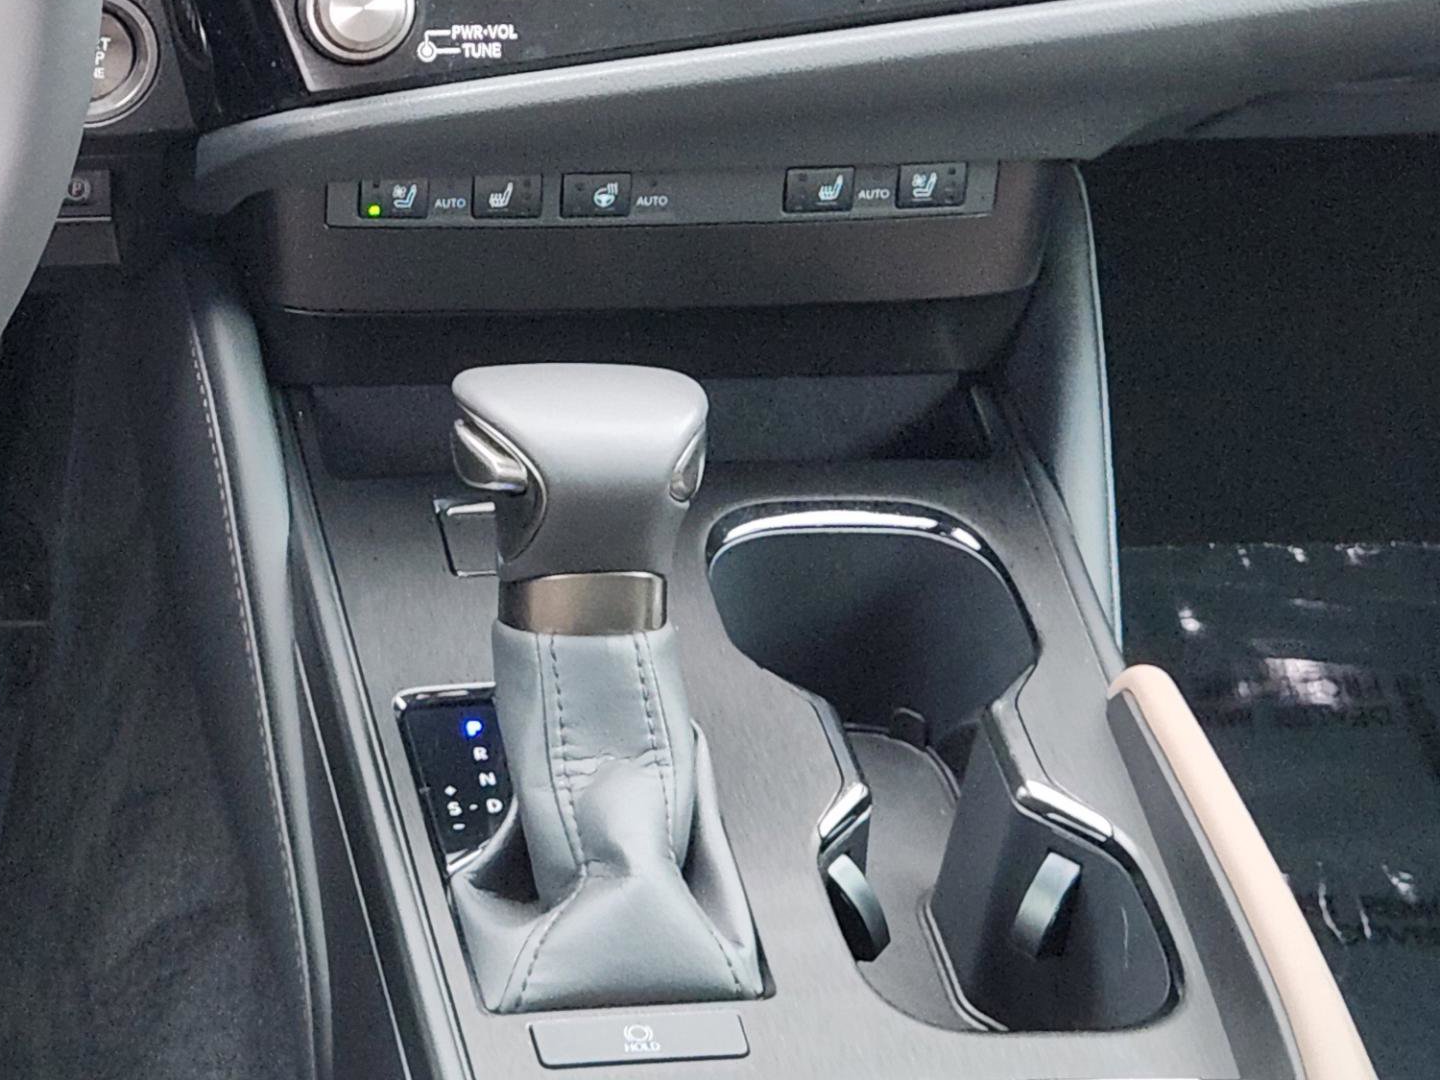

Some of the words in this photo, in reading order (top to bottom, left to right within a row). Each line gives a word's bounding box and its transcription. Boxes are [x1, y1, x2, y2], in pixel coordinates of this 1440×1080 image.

[461, 42, 502, 59] TUNE
[858, 187, 891, 200] AUTO
[434, 196, 467, 209] AUTO
[636, 195, 669, 208] AUTO
[466, 720, 483, 737] P
[473, 746, 489, 761] R
[479, 772, 497, 787] N
[446, 801, 463, 816] S
[486, 798, 503, 814] D
